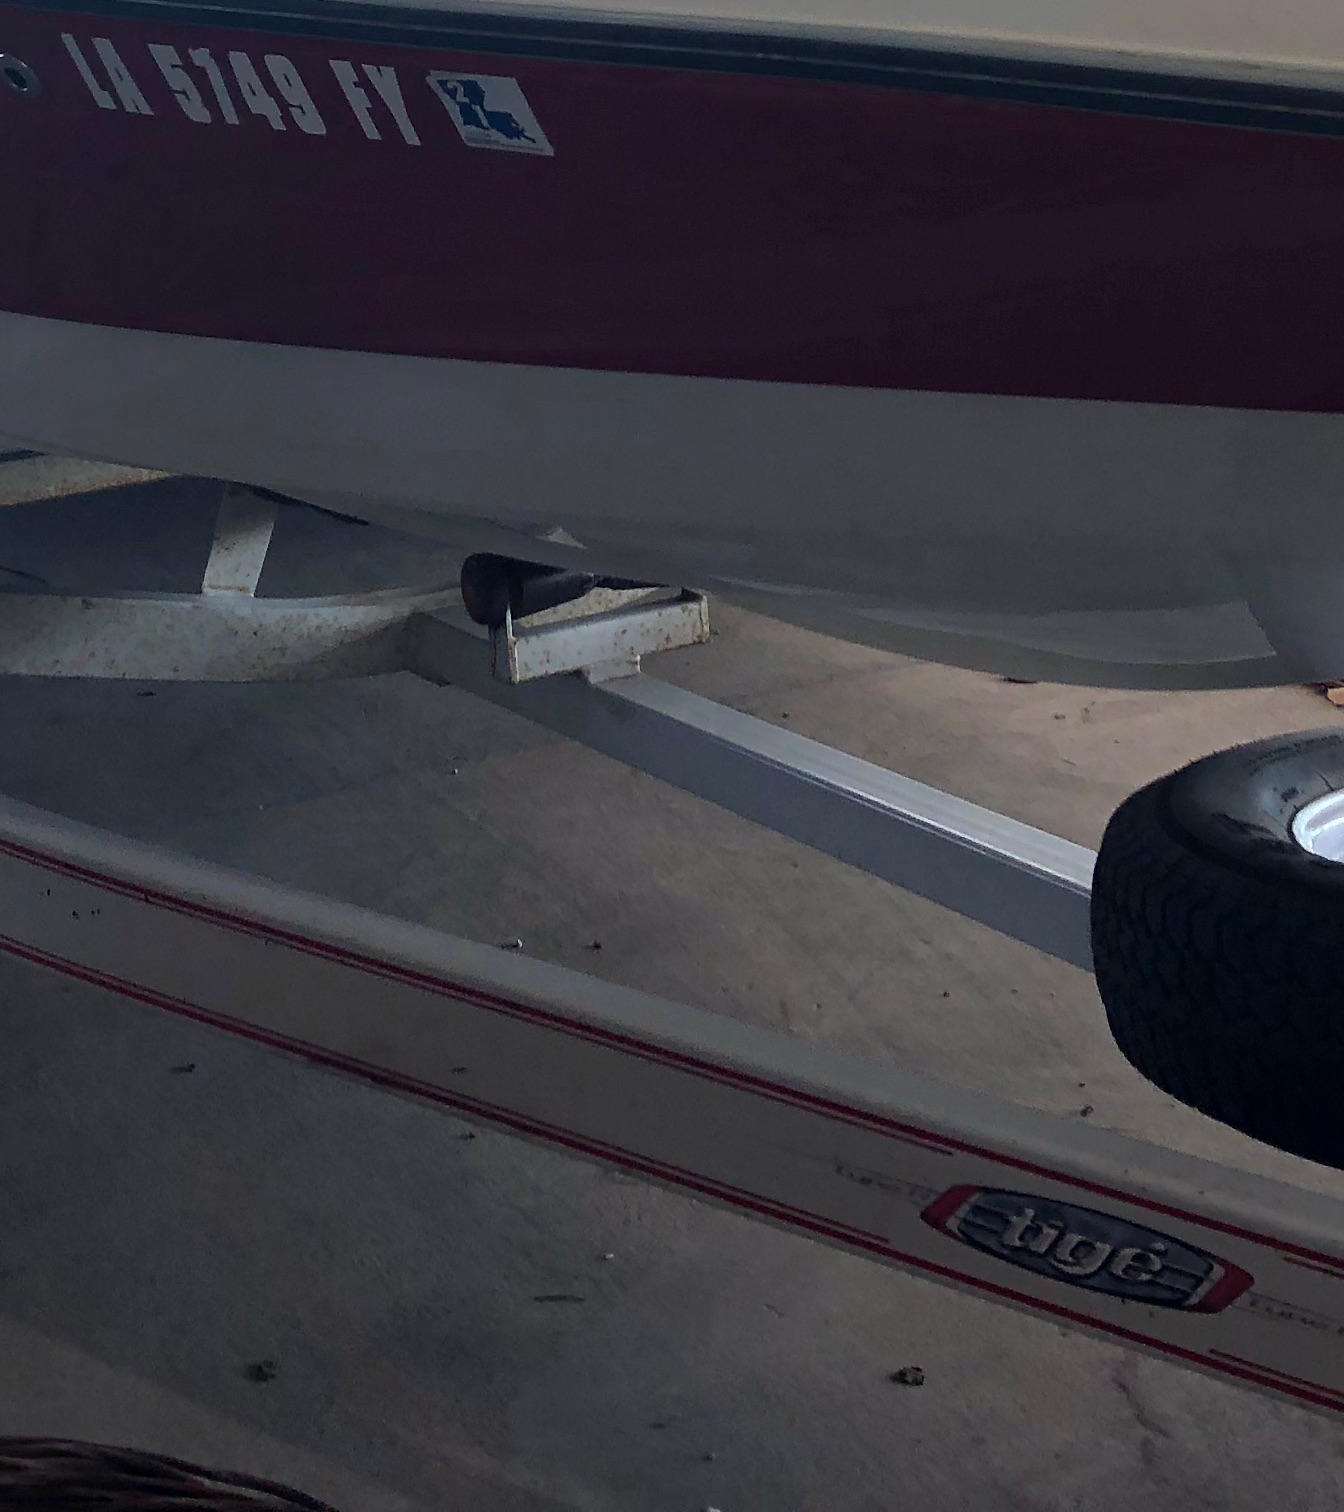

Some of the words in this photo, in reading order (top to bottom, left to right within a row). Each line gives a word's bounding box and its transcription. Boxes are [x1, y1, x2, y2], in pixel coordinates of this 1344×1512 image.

[60, 32, 155, 116] LA
[147, 43, 327, 135] 5749
[328, 59, 422, 146] FY
[1001, 1207, 1169, 1282] tigé
